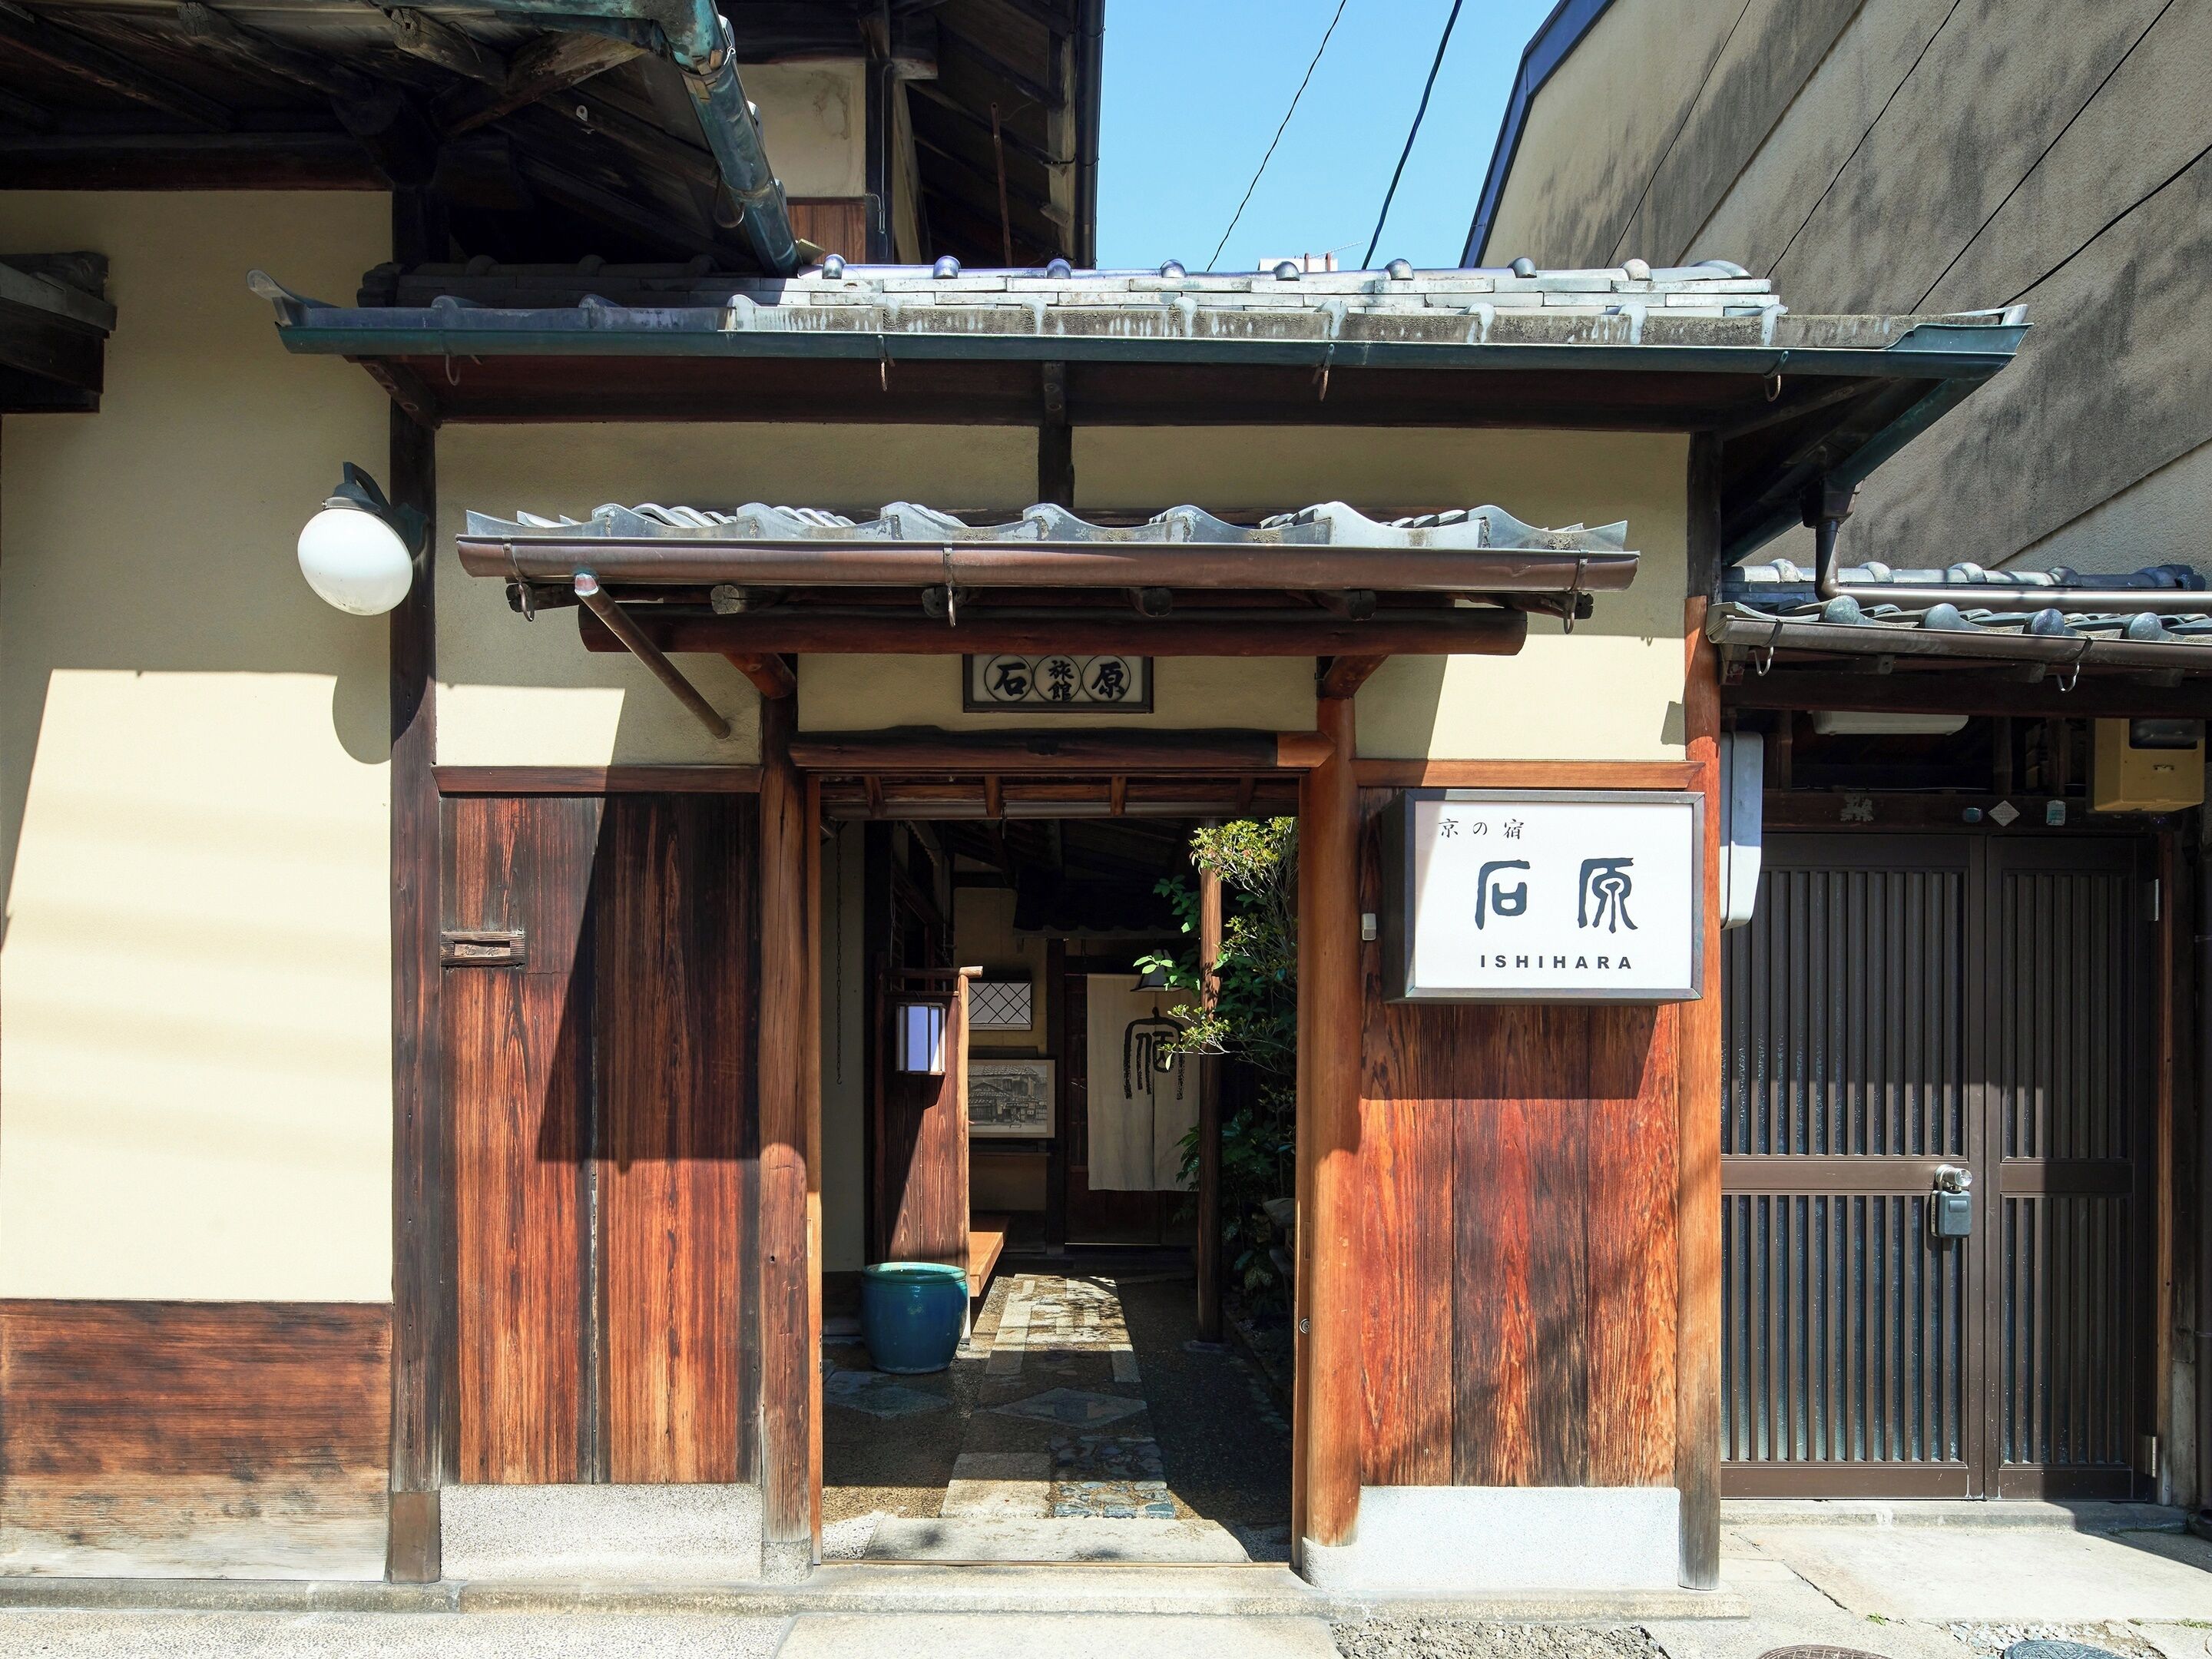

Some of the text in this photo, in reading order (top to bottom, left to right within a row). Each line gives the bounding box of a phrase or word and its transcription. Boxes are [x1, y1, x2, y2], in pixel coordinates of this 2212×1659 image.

[994, 662, 1028, 697] 石
[1091, 661, 1126, 698] 原
[1438, 818, 1525, 839] 京の宿
[1475, 857, 1638, 934] 石原
[1480, 955, 1631, 969] ISHIHARA
